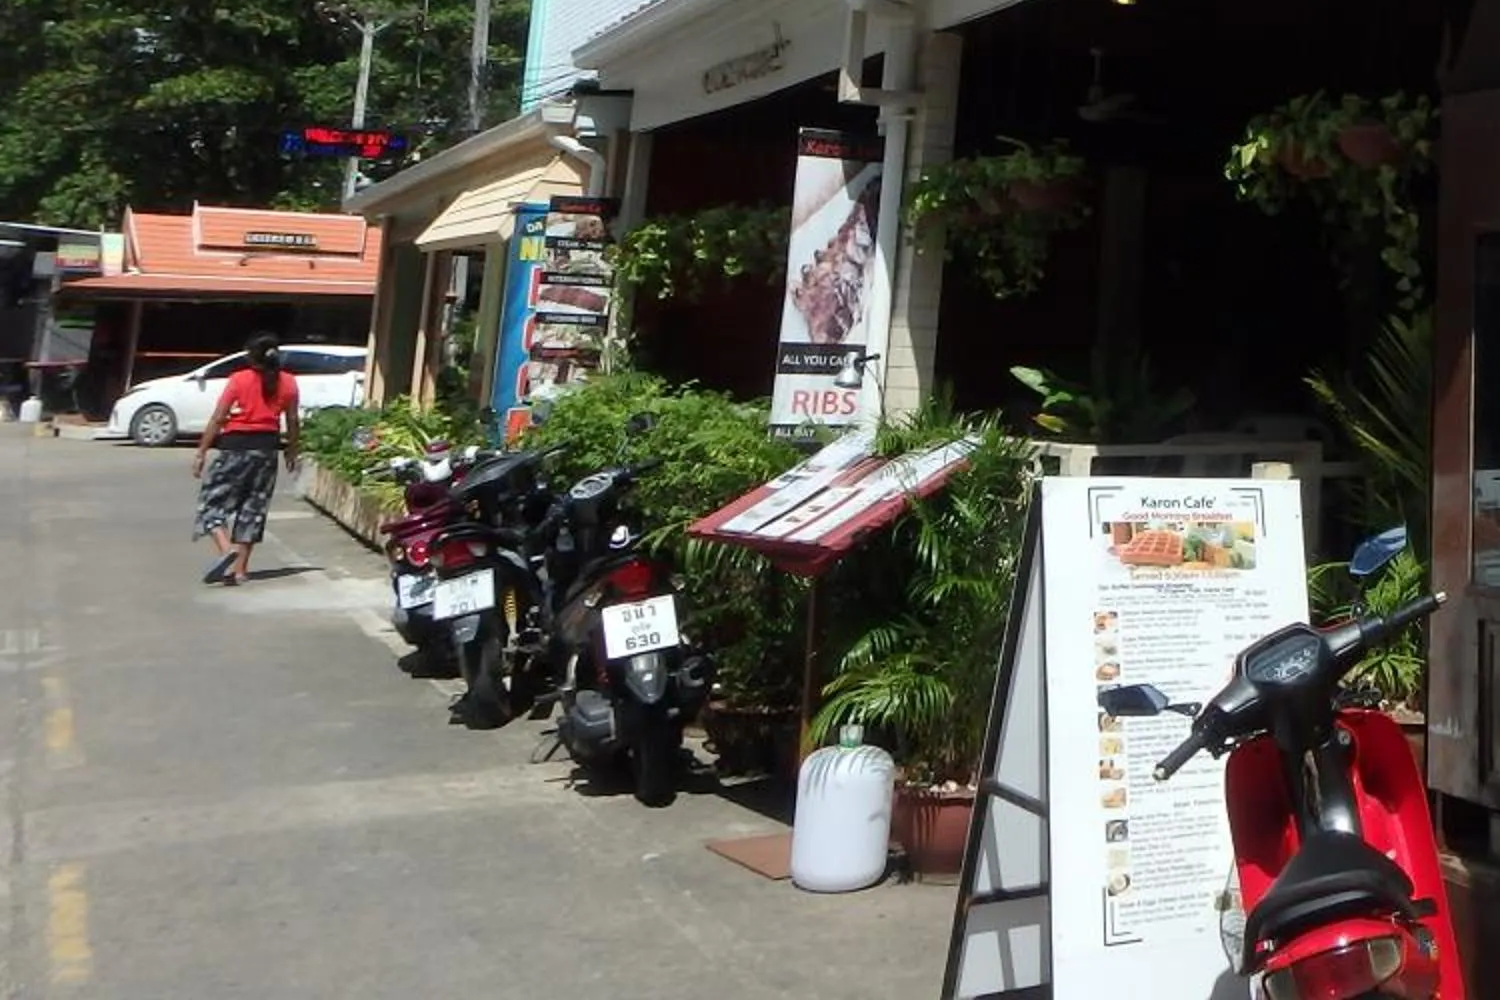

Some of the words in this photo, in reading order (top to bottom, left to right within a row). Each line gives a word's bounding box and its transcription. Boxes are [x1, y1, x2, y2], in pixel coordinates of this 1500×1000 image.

[804, 354, 826, 366] YOU
[791, 389, 857, 415] RIBS
[1141, 496, 1181, 509] Karon
[625, 632, 661, 650] 630
